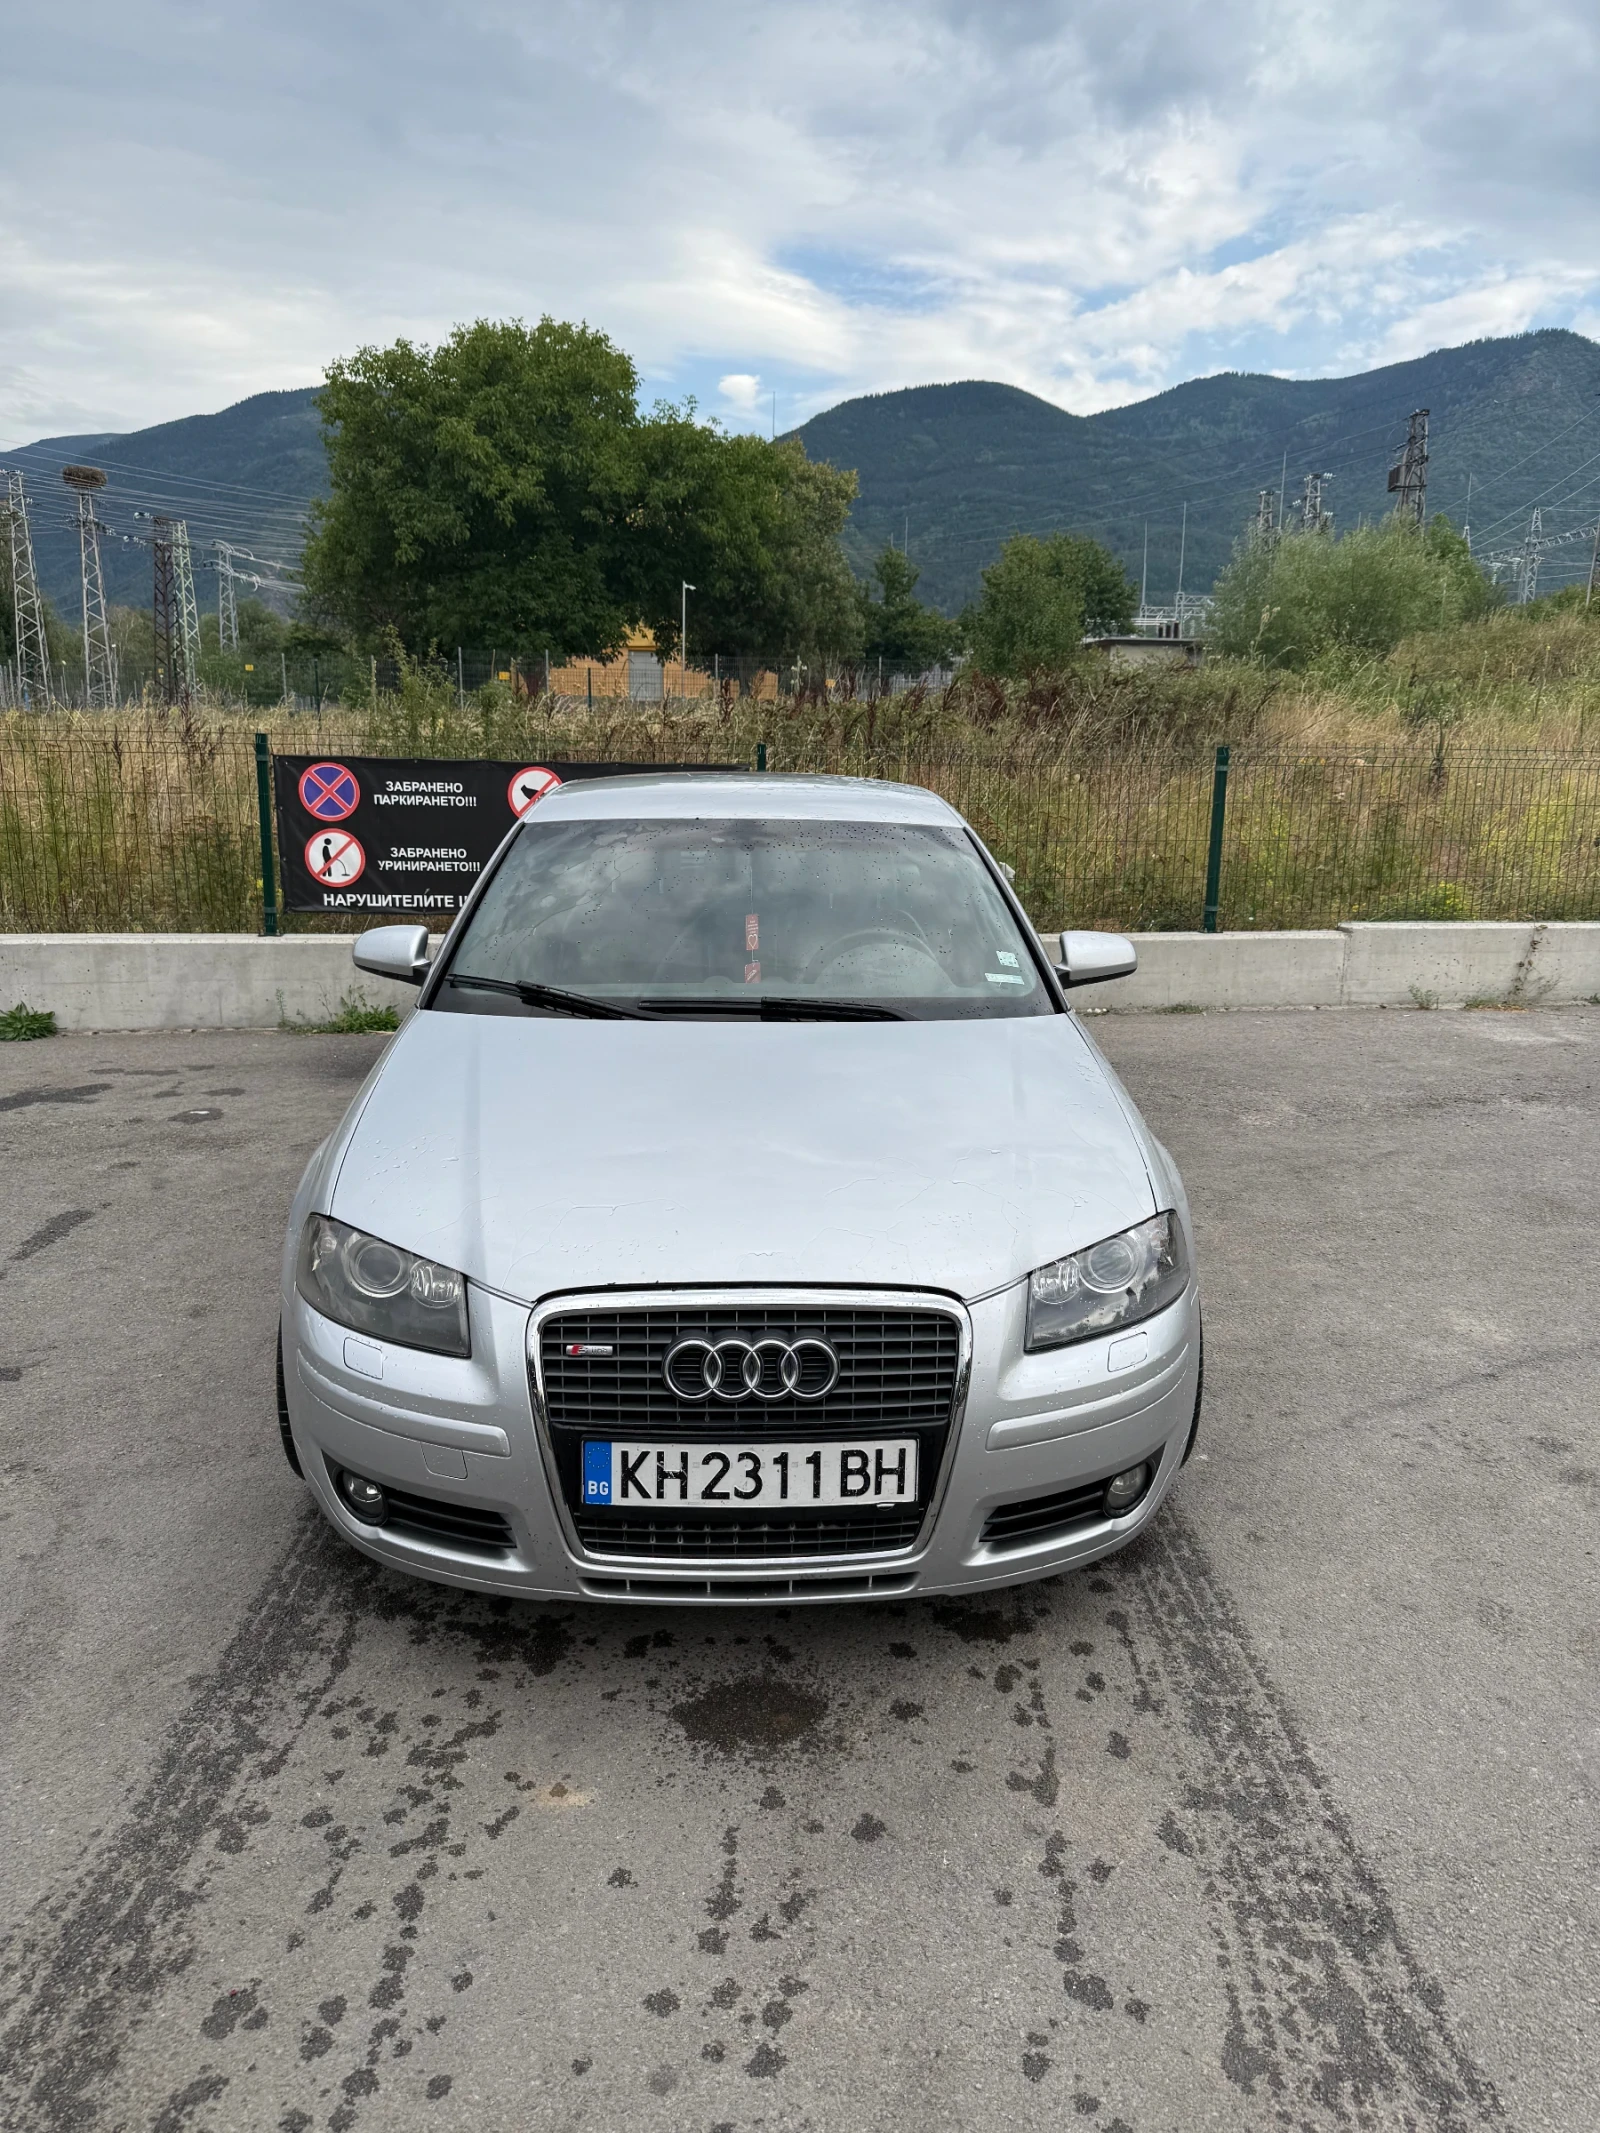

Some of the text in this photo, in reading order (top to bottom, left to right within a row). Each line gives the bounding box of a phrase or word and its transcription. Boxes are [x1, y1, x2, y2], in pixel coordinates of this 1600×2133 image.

[385, 780, 463, 793] ЗАБРАНЕНО
[373, 794, 477, 807] ПАРКИРАНЕТО!!!
[390, 847, 467, 859] ЗАБРАНЕНО
[377, 860, 481, 872] УРИНИРАНЕТО!!!
[323, 893, 455, 908] НАРУШИТЕЛИТЕ
[587, 1480, 609, 1496] BG
